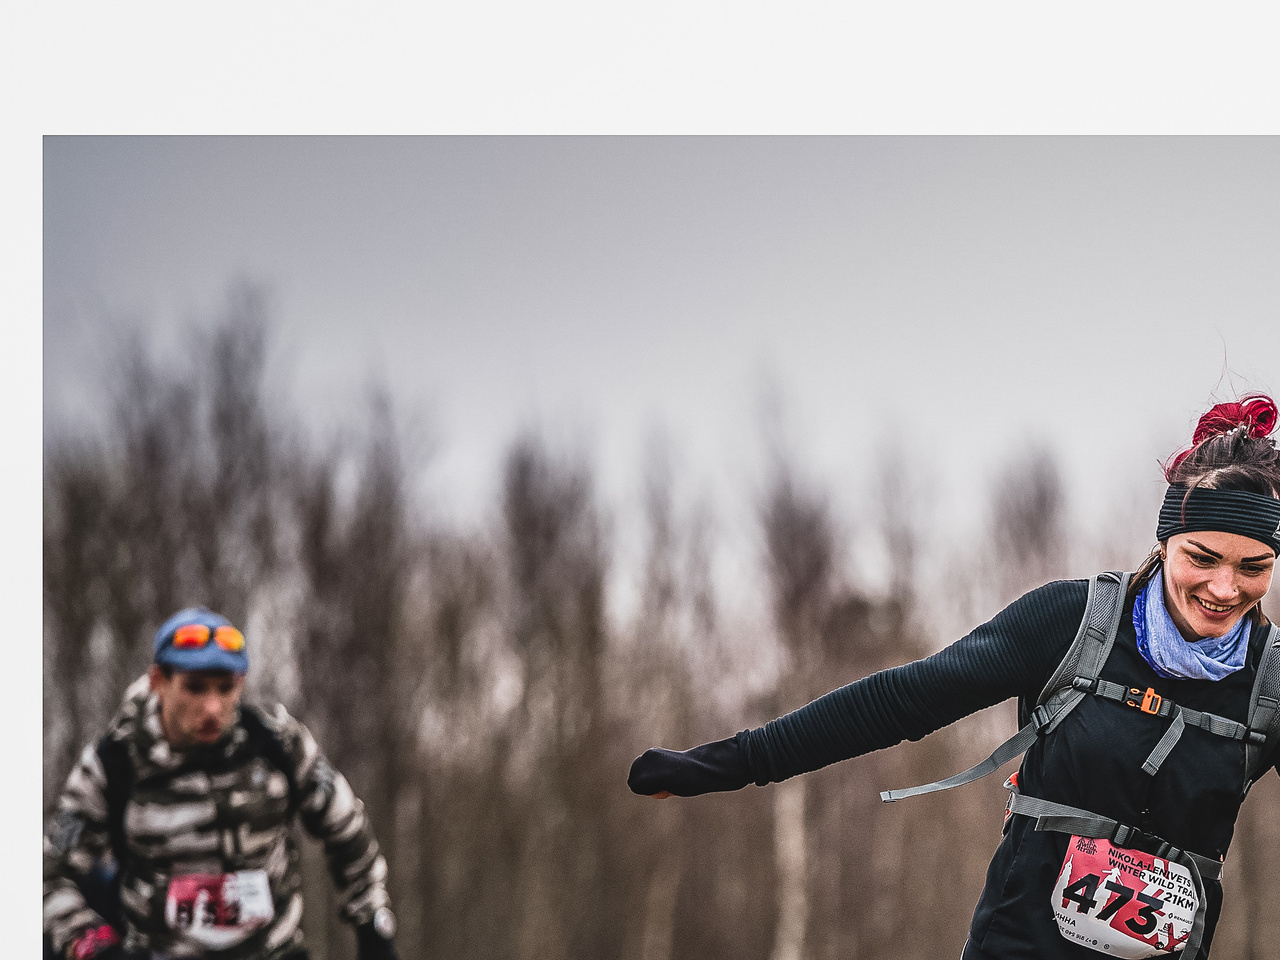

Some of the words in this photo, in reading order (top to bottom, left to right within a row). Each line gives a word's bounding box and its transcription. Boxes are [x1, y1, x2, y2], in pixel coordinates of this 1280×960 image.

[1108, 848, 1192, 887] NIKOLA-LENIVETS
[1109, 858, 1146, 880] WINTER
[1148, 875, 1175, 890] WILD
[1063, 873, 1164, 935] 473
[1164, 892, 1194, 911] 21KM
